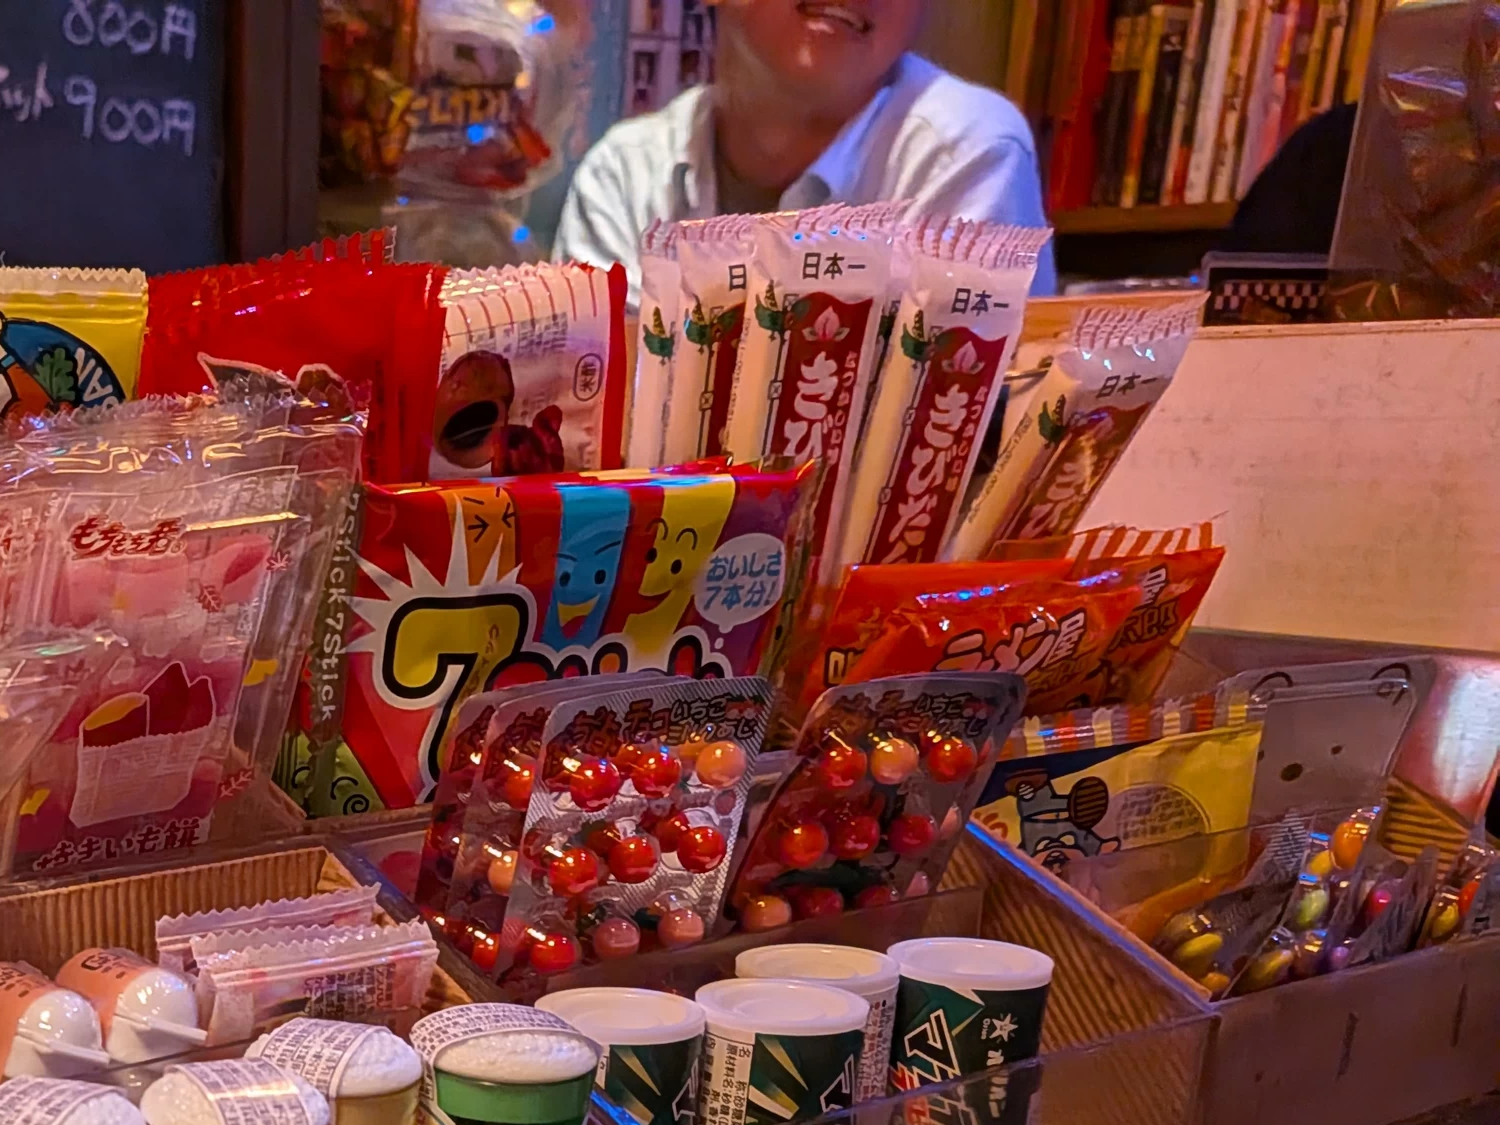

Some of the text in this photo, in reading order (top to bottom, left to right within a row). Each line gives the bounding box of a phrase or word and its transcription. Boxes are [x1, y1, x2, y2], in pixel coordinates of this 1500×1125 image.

[64, 76, 197, 157] 900円
[803, 253, 865, 280] 日本一
[951, 288, 1009, 316] 日本一
[1096, 374, 1157, 398] 日本一
[881, 384, 969, 563] きびだ
[707, 550, 782, 582] おいしさ
